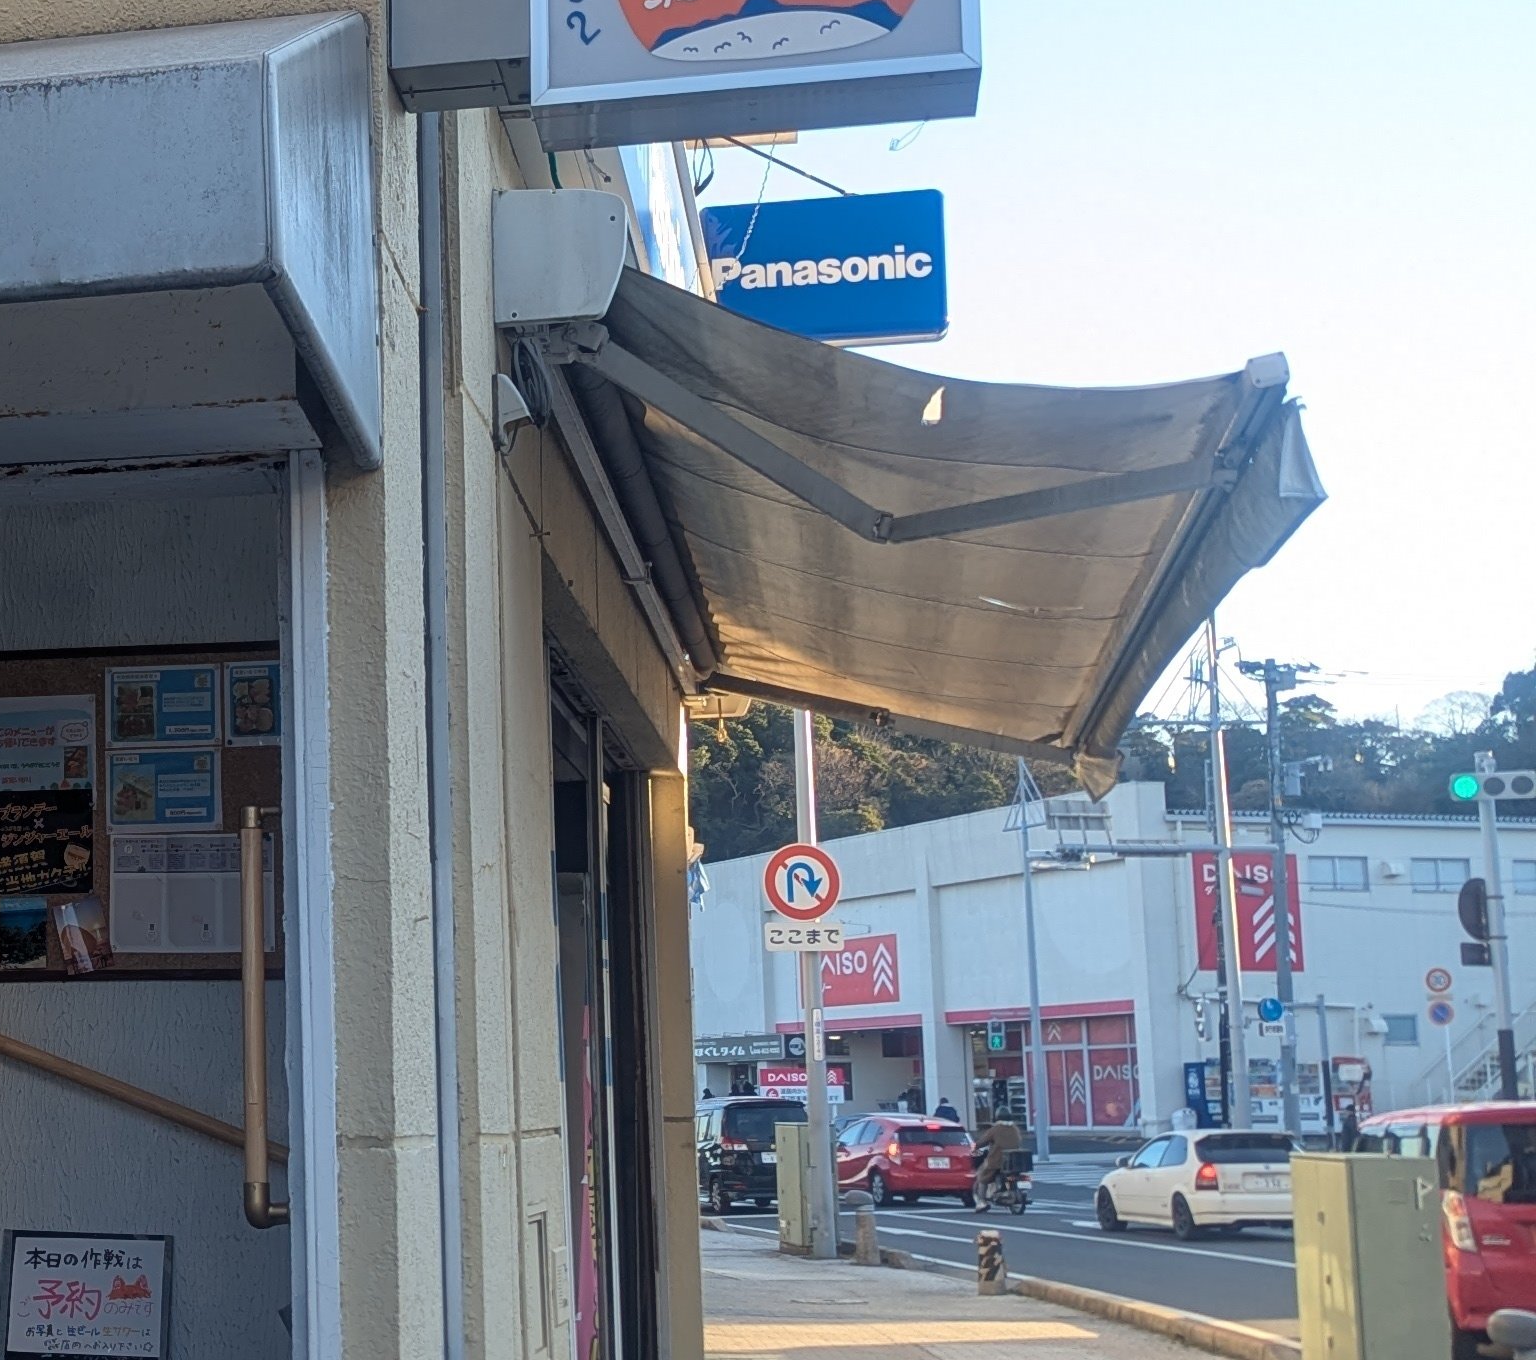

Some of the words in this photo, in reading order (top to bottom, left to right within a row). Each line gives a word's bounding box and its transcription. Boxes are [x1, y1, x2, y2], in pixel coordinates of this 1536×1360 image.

[711, 244, 933, 291] Panasonic
[769, 929, 841, 945] ここまで
[767, 1072, 808, 1083] DAISO
[24, 1247, 143, 1270] 本日の作戦は
